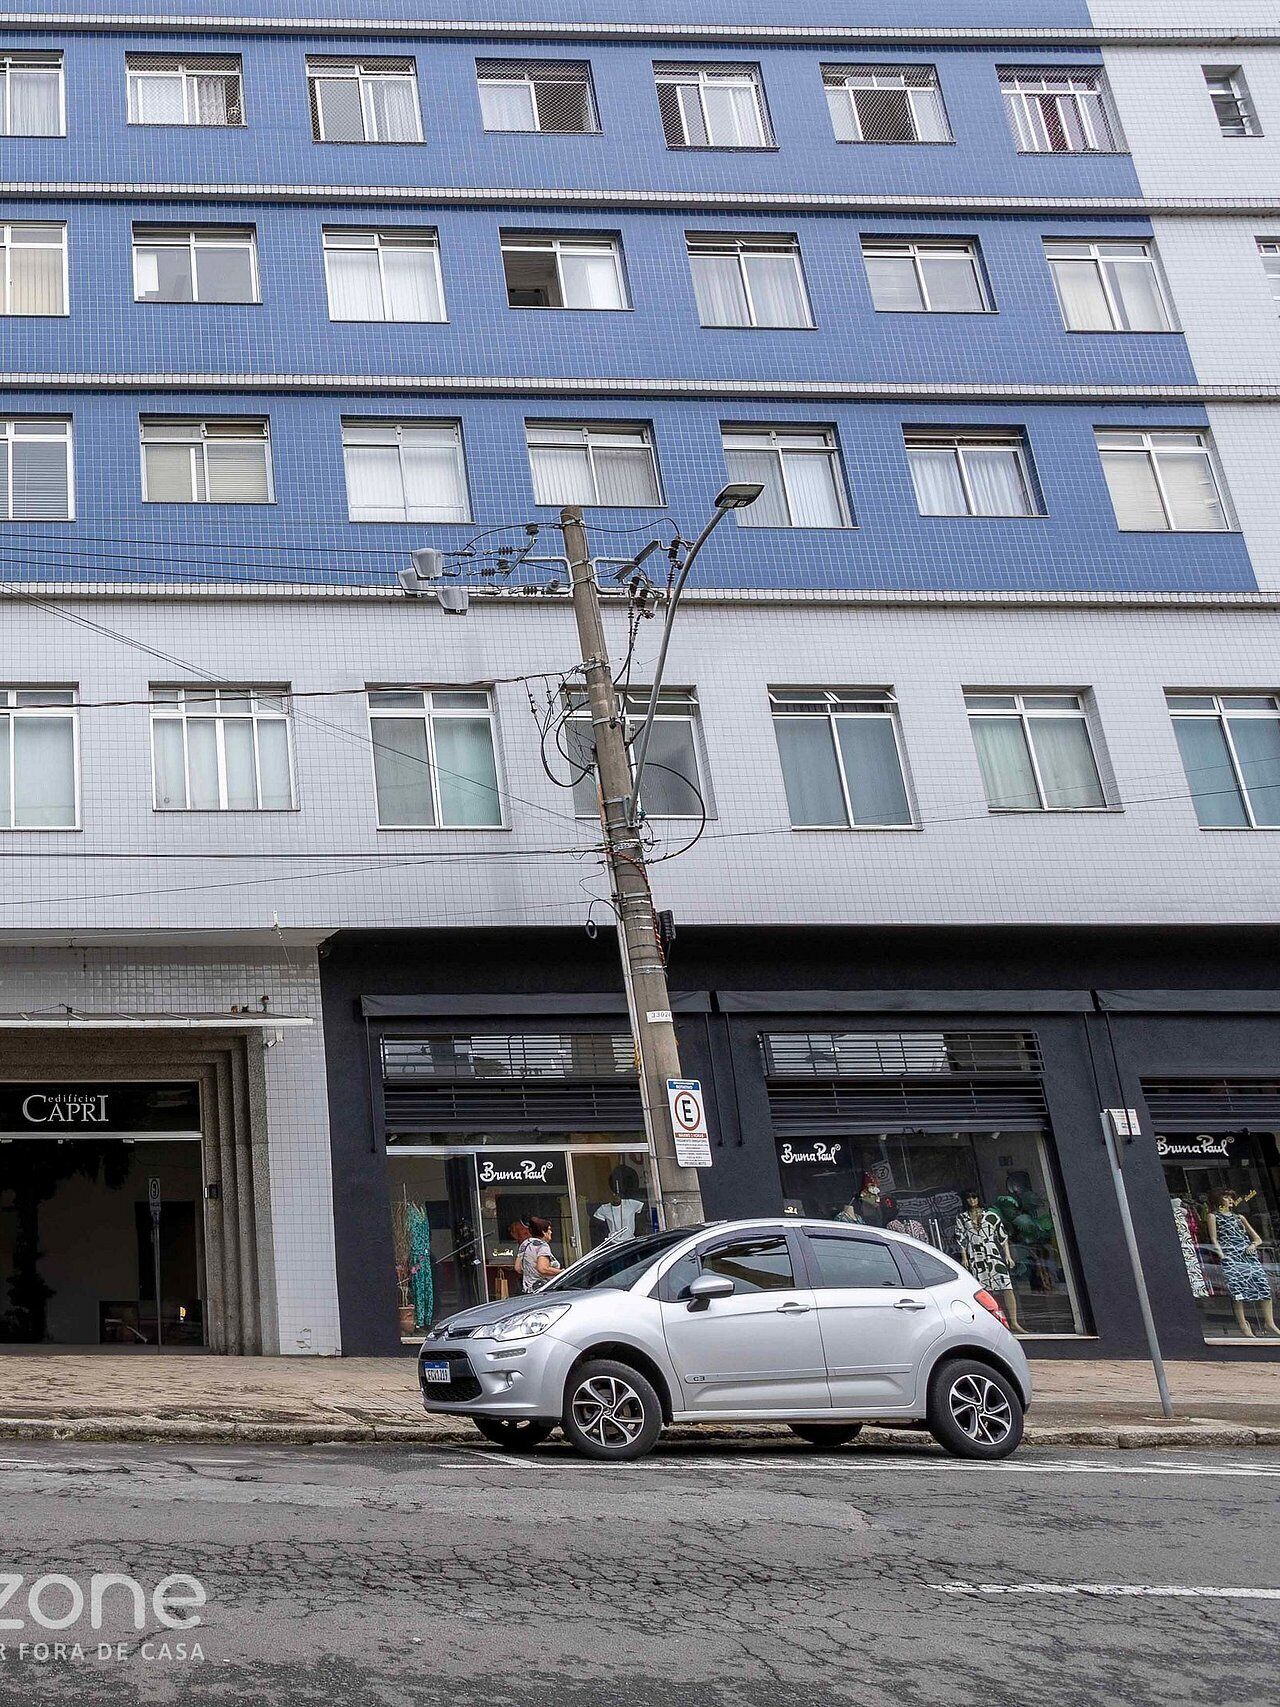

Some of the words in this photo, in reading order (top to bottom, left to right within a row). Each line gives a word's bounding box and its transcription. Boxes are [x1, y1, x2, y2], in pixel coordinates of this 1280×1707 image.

[682, 1099, 693, 1123] E
[781, 1143, 817, 1164] Bruna
[1155, 1135, 1202, 1156] Bruna
[480, 1161, 522, 1182] Bruna
